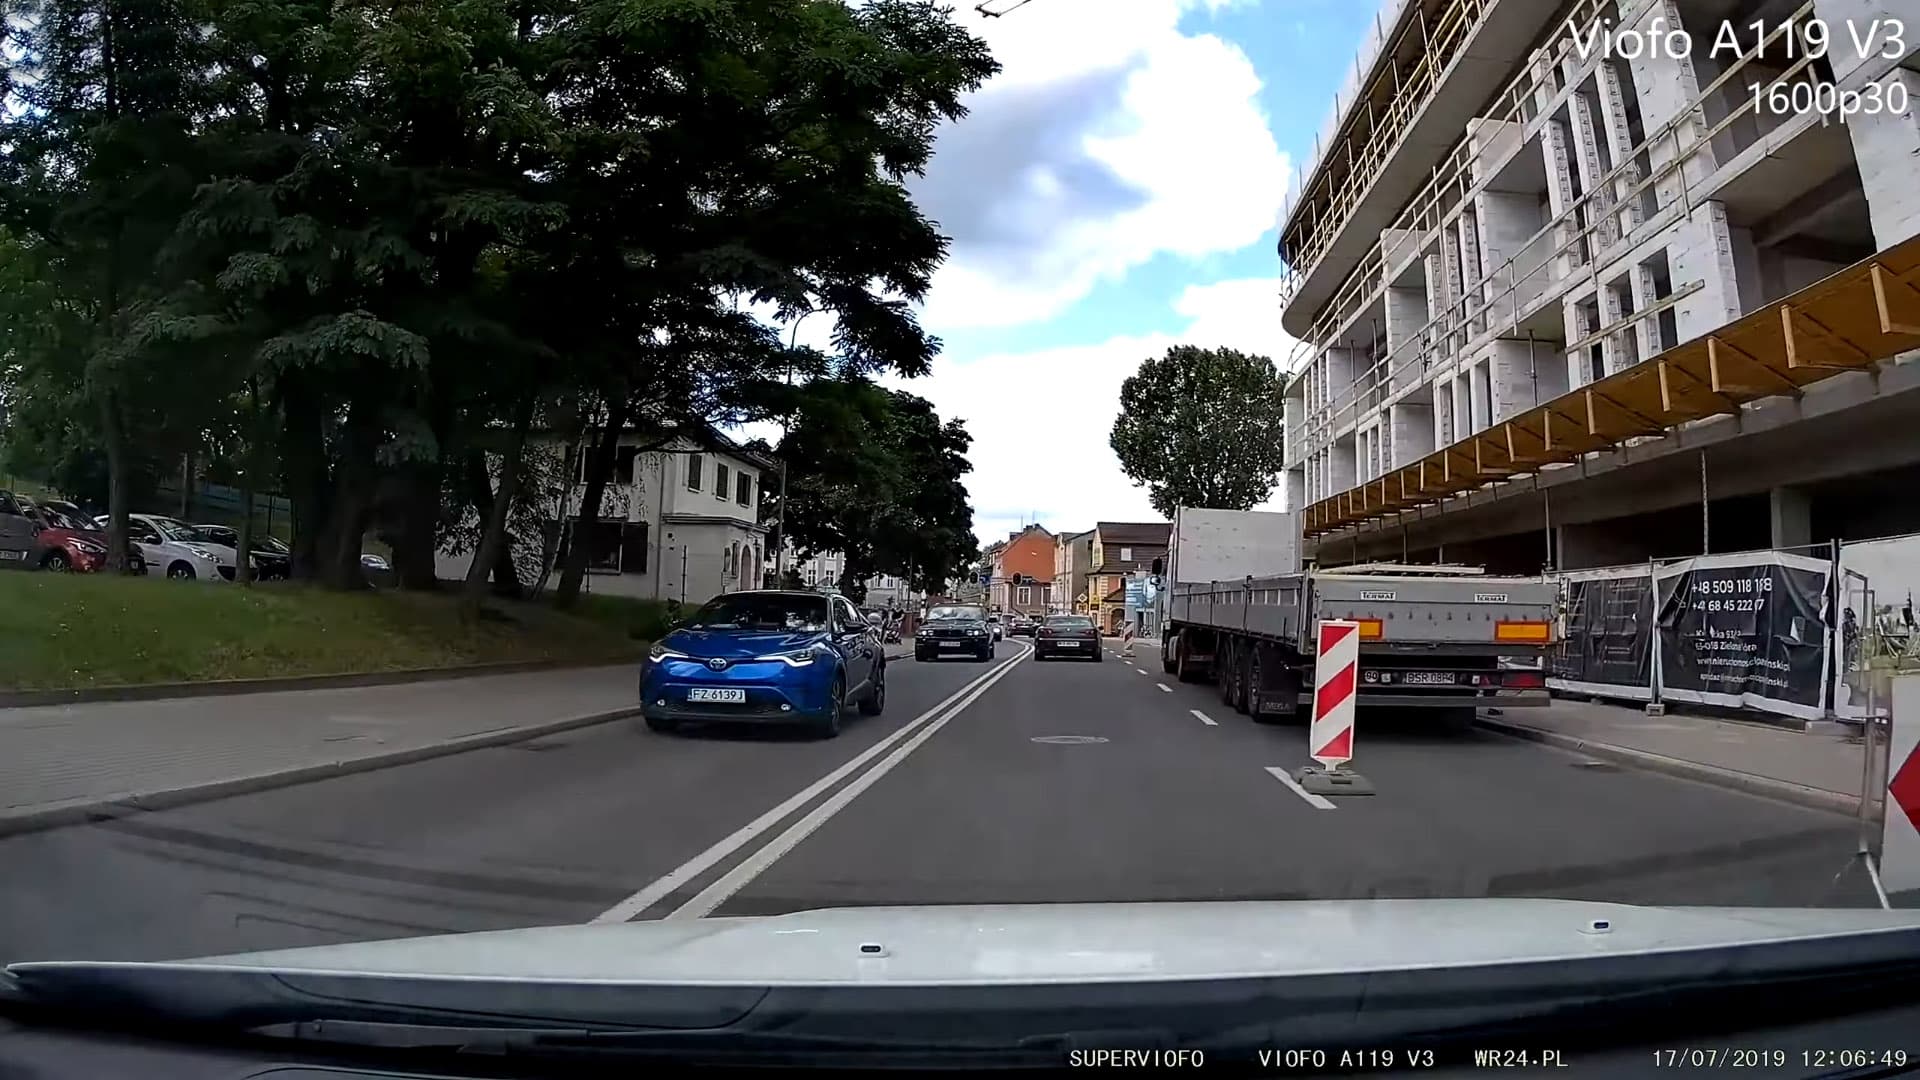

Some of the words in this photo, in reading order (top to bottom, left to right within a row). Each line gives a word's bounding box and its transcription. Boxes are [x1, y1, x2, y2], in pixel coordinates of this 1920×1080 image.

[1712, 580, 1734, 593] 509
[1736, 579, 1752, 593] 118
[1708, 600, 1721, 611] 68
[1723, 600, 1735, 611] 45
[1737, 600, 1753, 611] 222
[693, 689, 708, 699] FZ
[711, 690, 743, 700] 6139J
